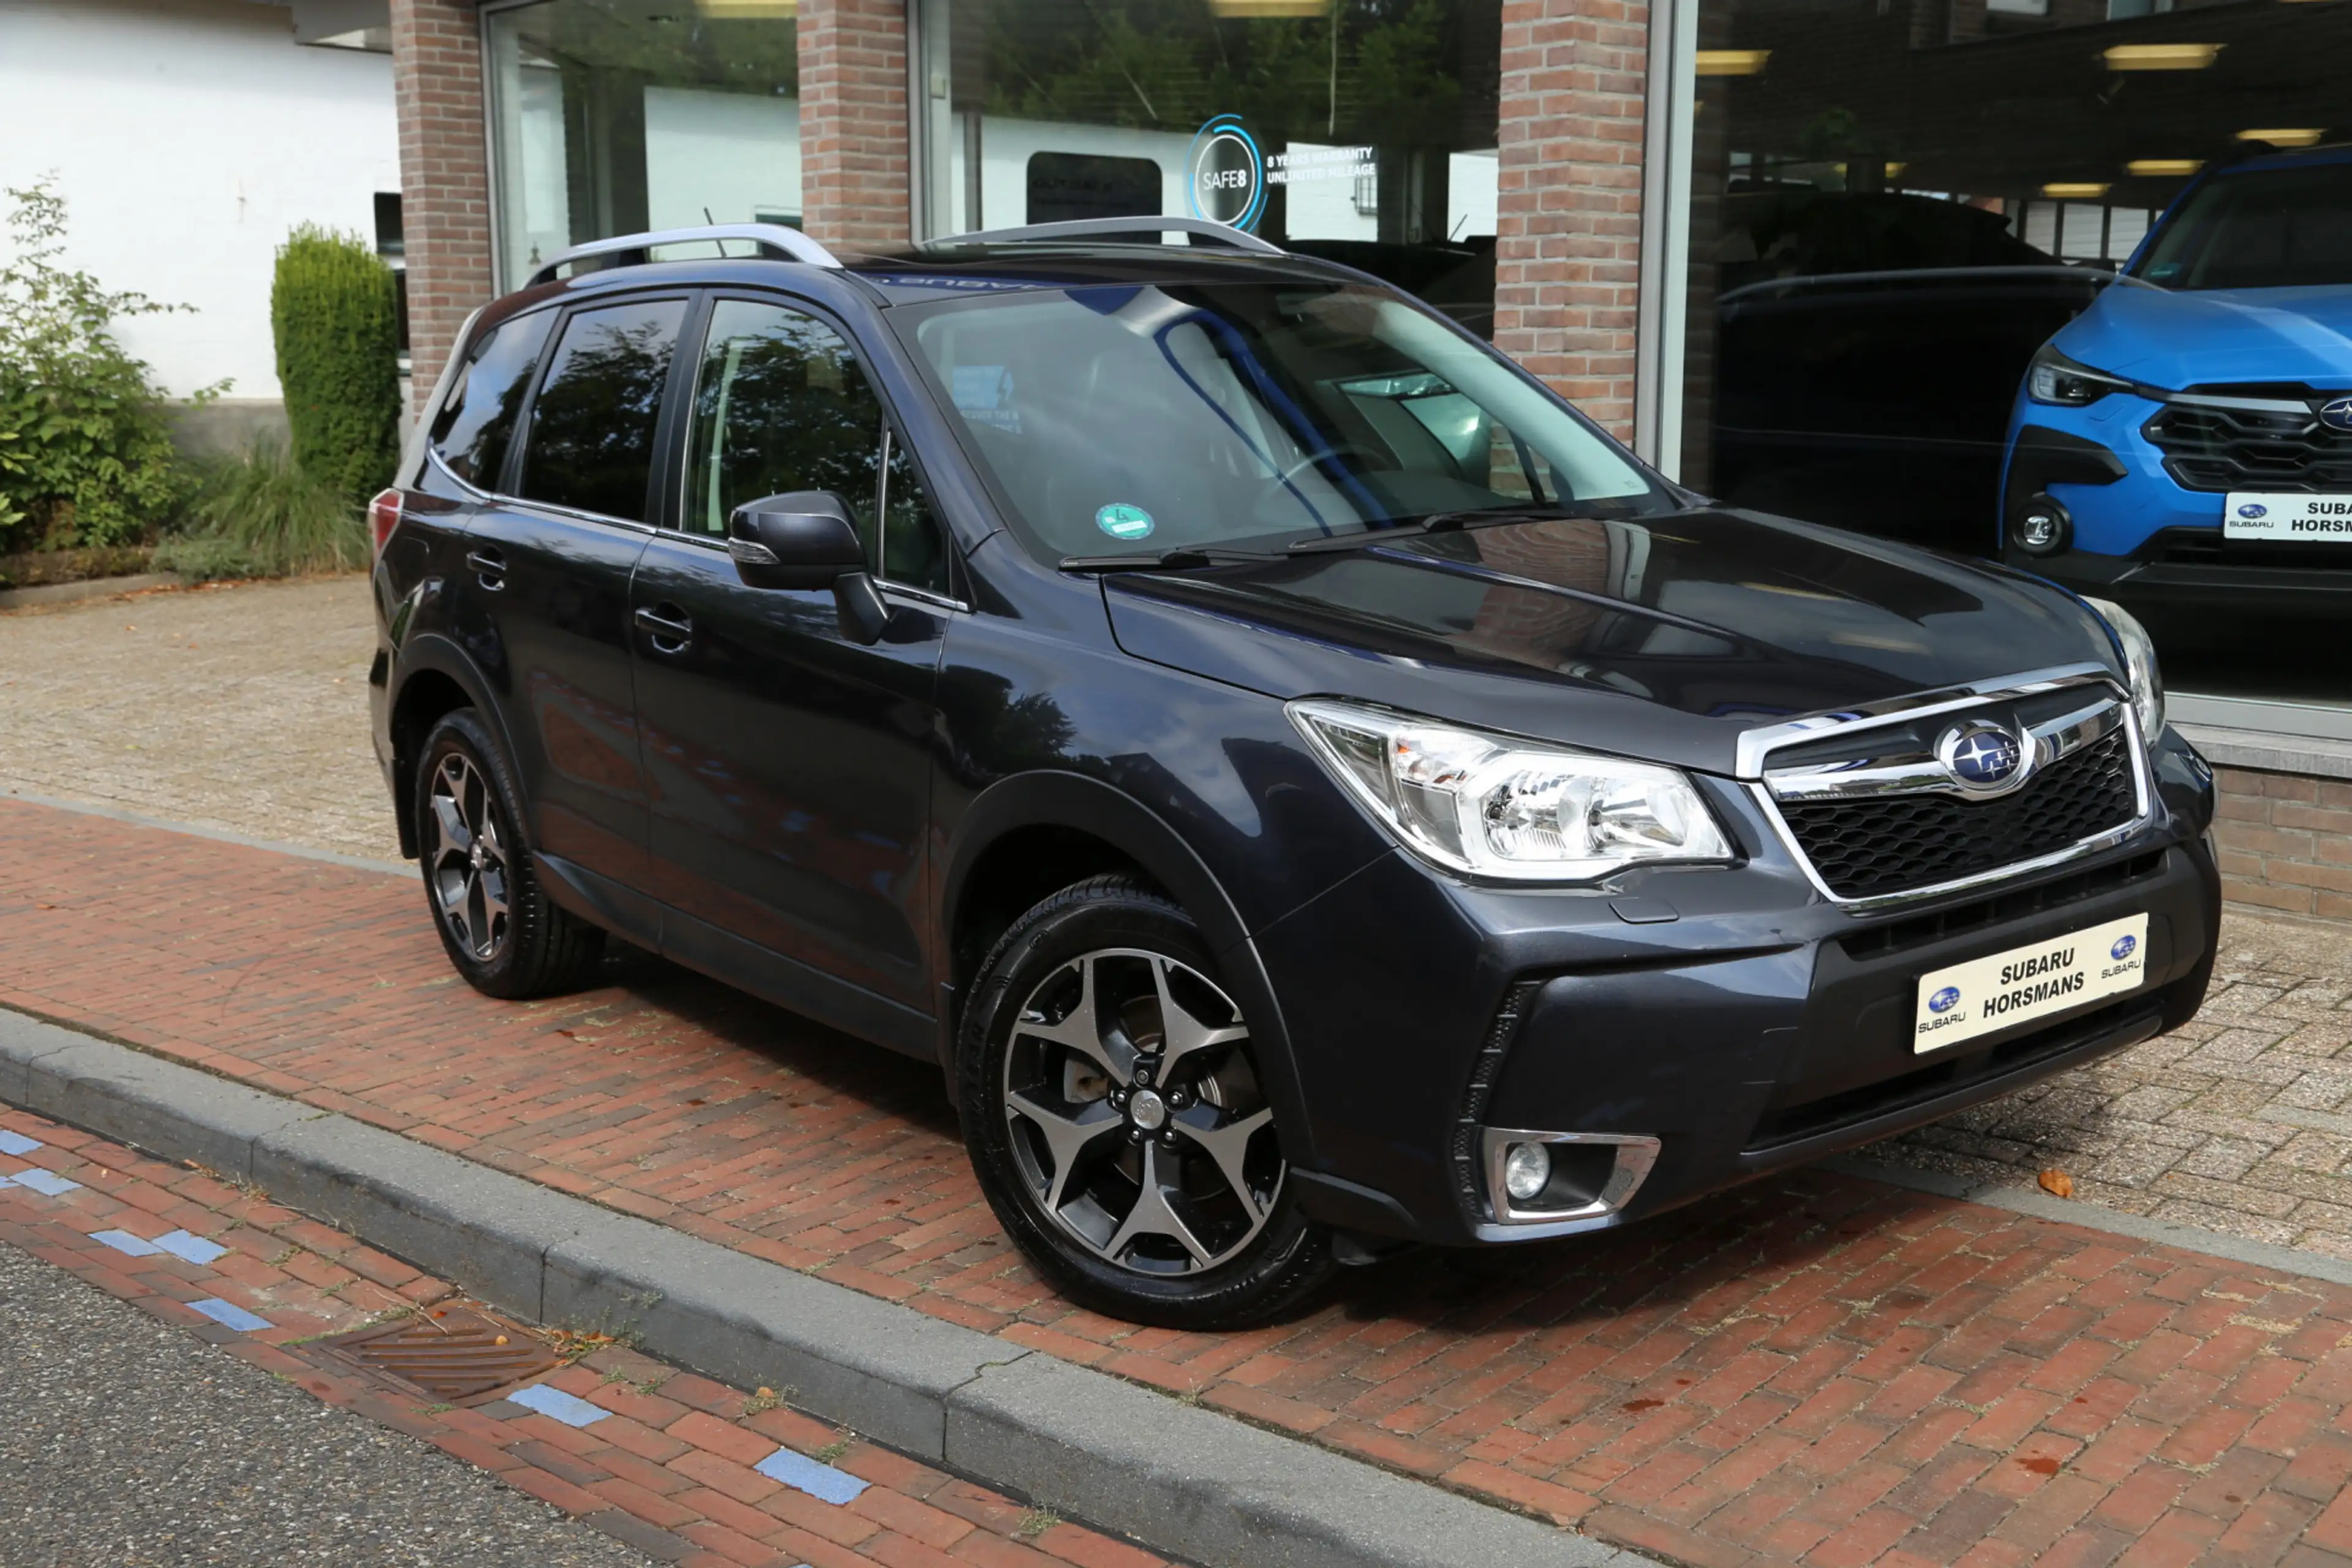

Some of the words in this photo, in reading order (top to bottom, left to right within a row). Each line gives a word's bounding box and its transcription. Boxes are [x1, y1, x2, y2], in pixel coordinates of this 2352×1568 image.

[1267, 156, 1275, 168] 8
[1276, 153, 1310, 167] YEARS
[1311, 147, 1372, 164] WARRANTY
[1202, 169, 1247, 190] SAFE8
[1267, 168, 1325, 184] UNLIMITED
[1329, 163, 1376, 178] MILEAGE
[2000, 948, 2075, 986] SUBARU
[2101, 959, 2141, 979] SUBARU
[1983, 971, 2084, 1019] HORSMANS
[1918, 1012, 1966, 1034] SUBARU
